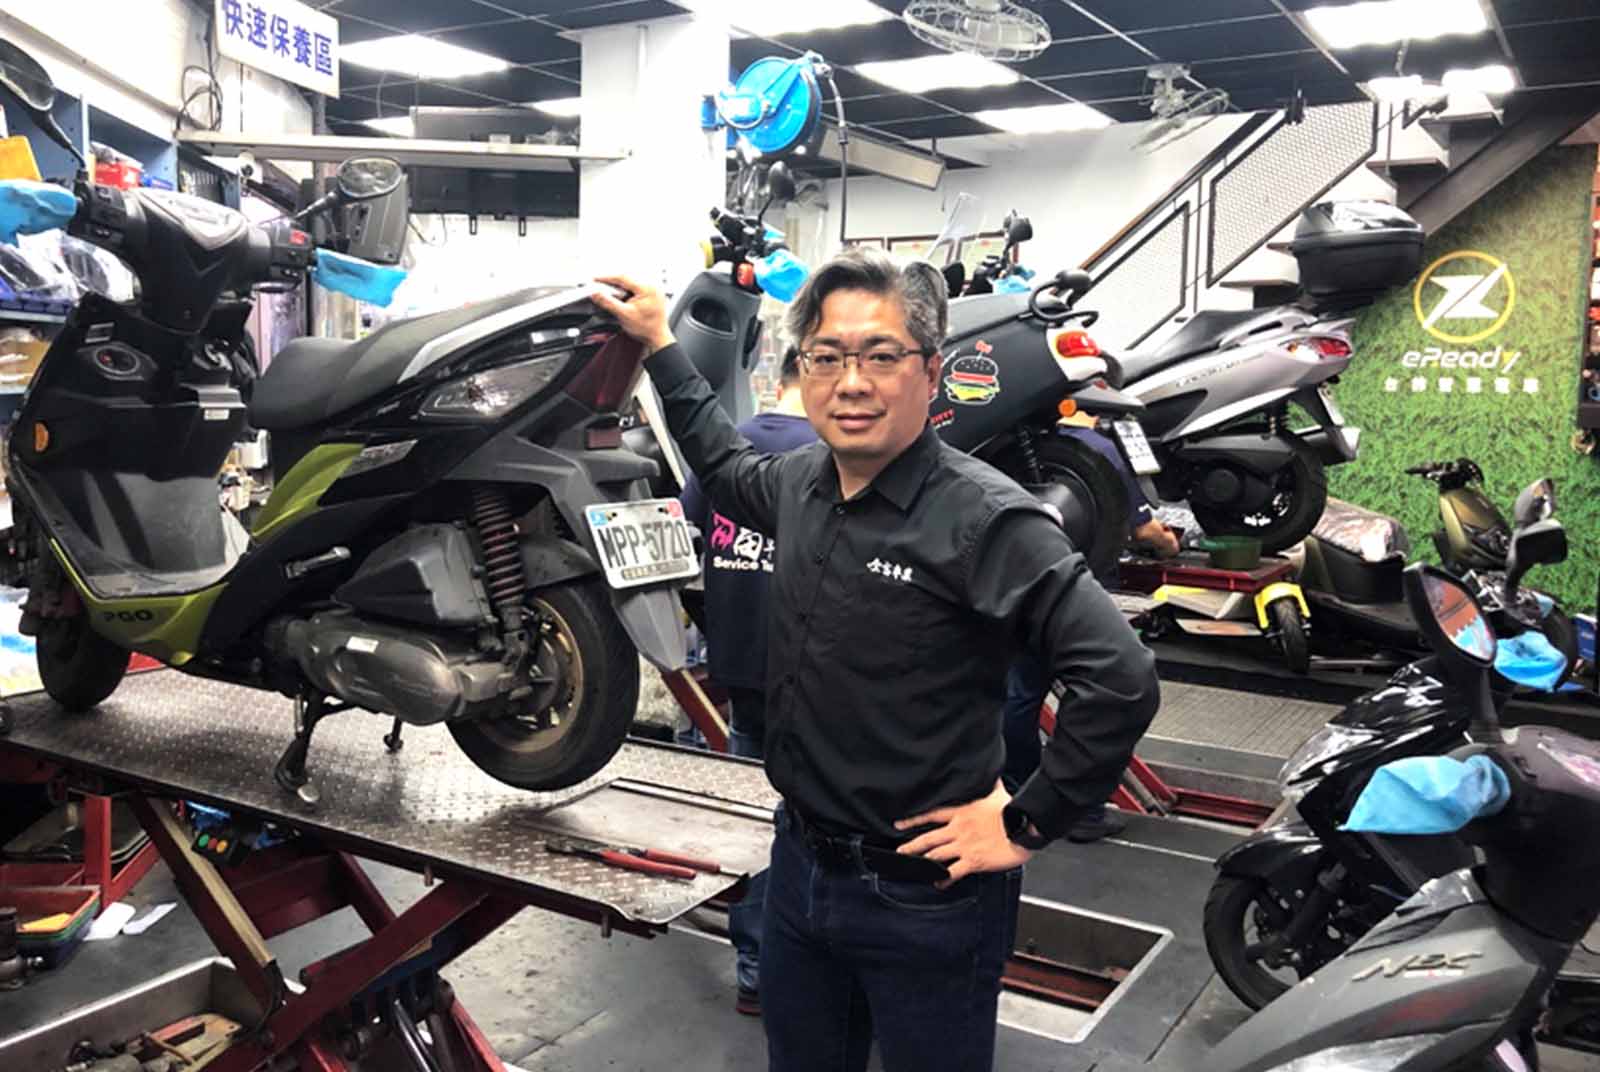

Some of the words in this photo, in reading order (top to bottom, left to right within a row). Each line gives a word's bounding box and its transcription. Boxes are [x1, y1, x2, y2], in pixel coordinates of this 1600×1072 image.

[221, 0, 334, 76] 快速保養區
[1401, 345, 1522, 374] eReady
[597, 520, 692, 569] MPP-5720
[102, 608, 153, 622] PGO
